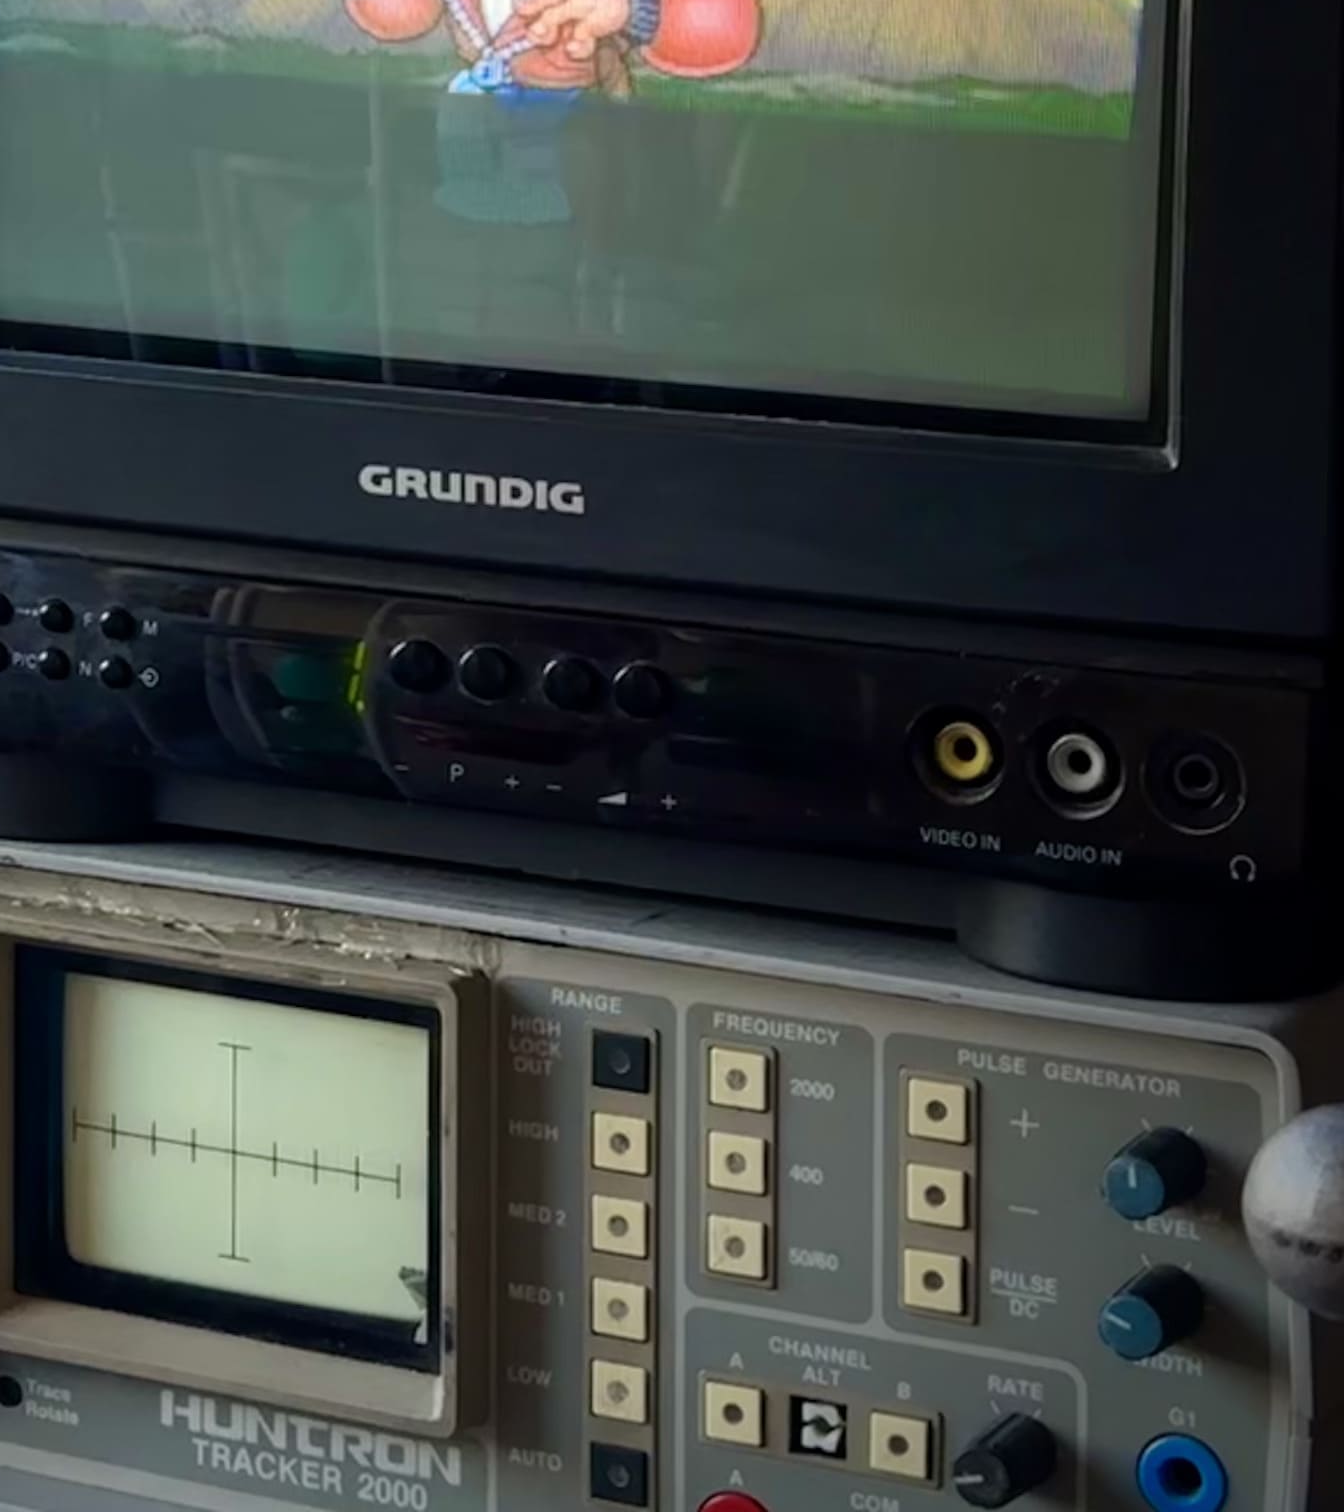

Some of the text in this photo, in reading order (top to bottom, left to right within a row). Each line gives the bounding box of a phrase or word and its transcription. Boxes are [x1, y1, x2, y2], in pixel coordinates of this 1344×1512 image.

[358, 463, 585, 515] GRUNDIG
[450, 762, 465, 783] P
[919, 826, 1002, 852] VIDEO IN
[1034, 840, 1123, 866] AUDIO IN
[551, 987, 623, 1015] RANGE
[511, 1015, 562, 1038] HIGH
[713, 1010, 840, 1046] FREQUENCY
[508, 1037, 561, 1057] LOCK
[513, 1057, 554, 1076] OUT
[957, 1048, 1182, 1098] PULSE GENERATOR
[789, 1078, 835, 1101] 2000
[508, 1119, 561, 1142] HIGH
[789, 1163, 824, 1185] 400
[508, 1202, 567, 1227] MED 2
[1132, 1217, 1202, 1241] LEVEL
[788, 1247, 839, 1272] 50/60
[990, 1267, 1058, 1296] PULSE
[508, 1283, 565, 1307] MED 1
[1010, 1297, 1040, 1319] DC
[728, 1351, 744, 1370] A
[768, 1335, 872, 1371] CHANNEL
[506, 1364, 553, 1386] LOW
[802, 1364, 842, 1387] ALT
[896, 1380, 912, 1400] B
[987, 1374, 1044, 1401] RATE
[25, 1400, 81, 1427] Rotate
[160, 1388, 461, 1486] HUNTRON
[507, 1448, 562, 1472] AUTO
[192, 1437, 428, 1511] TRACKER 2000
[728, 1468, 744, 1487] A
[850, 1491, 900, 1512] COM
